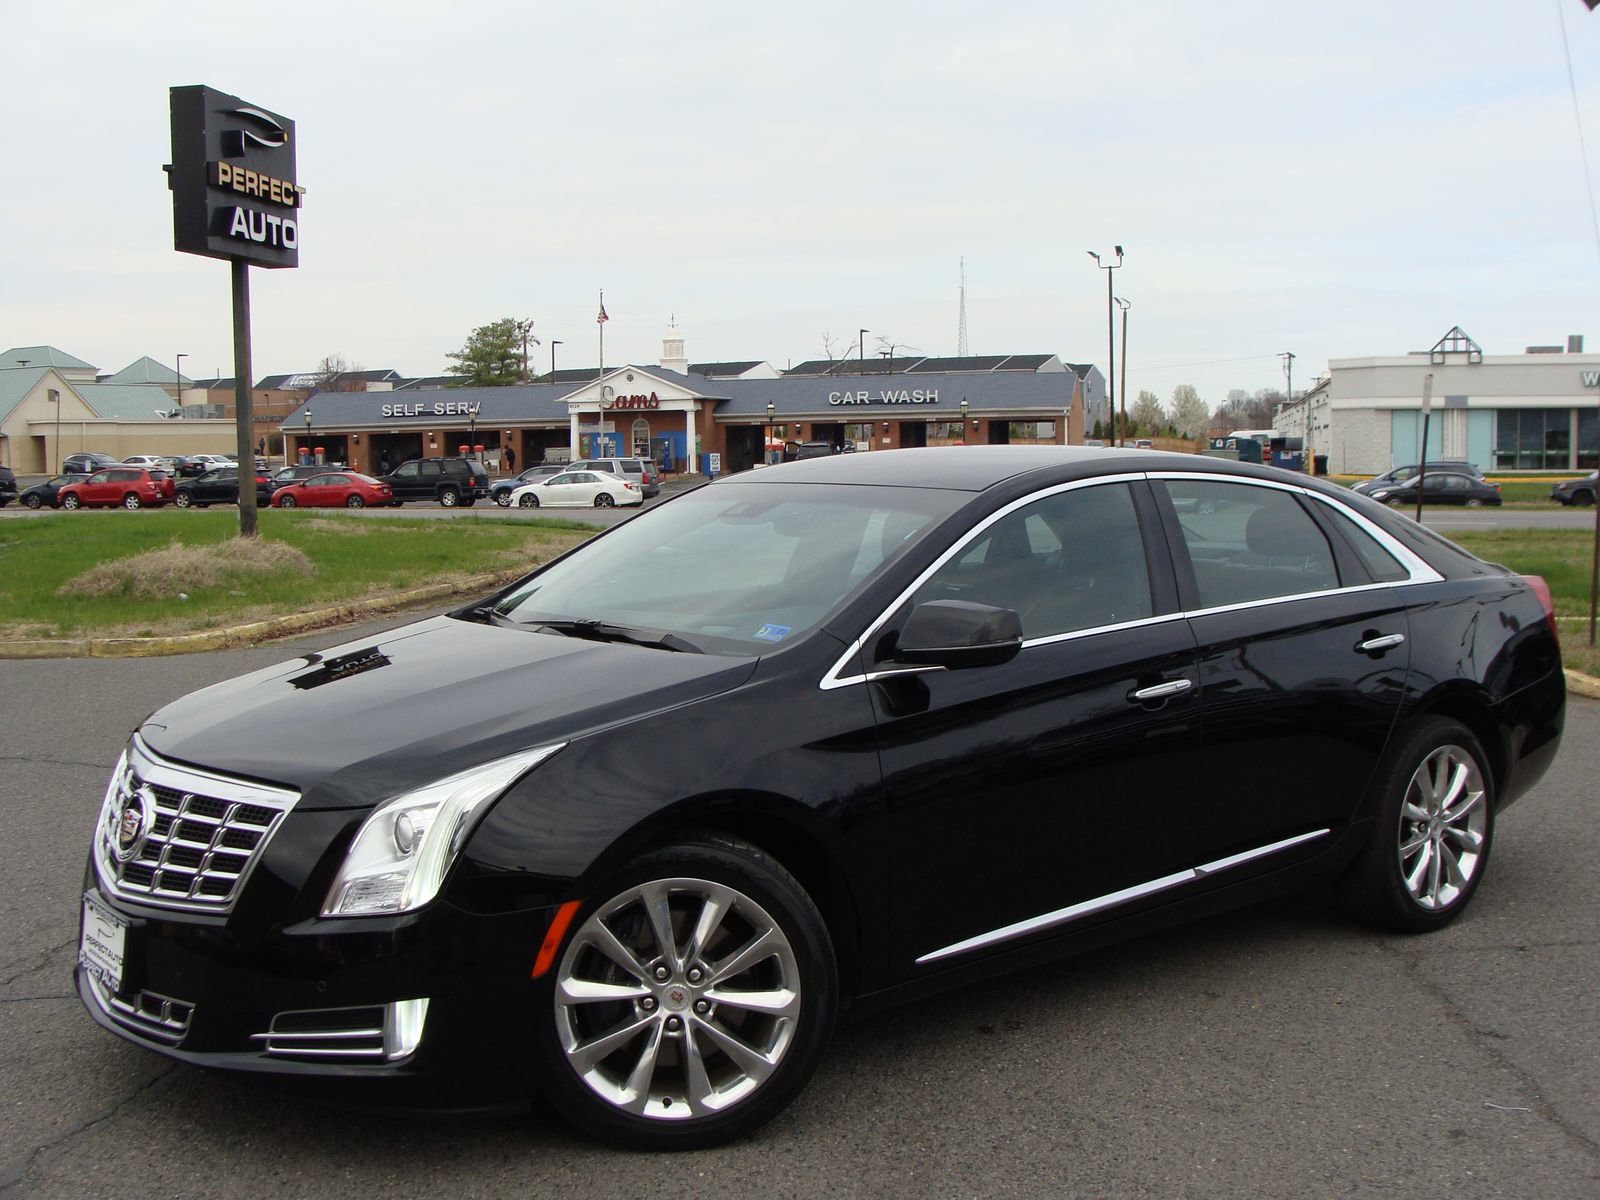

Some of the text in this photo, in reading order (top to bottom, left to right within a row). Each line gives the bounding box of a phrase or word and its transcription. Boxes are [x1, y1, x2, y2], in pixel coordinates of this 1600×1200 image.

[218, 160, 306, 207] PERFECT
[230, 206, 297, 249] AUTO
[599, 386, 661, 410] Sams
[829, 389, 939, 405] CAR WASH
[382, 403, 424, 416] SELF
